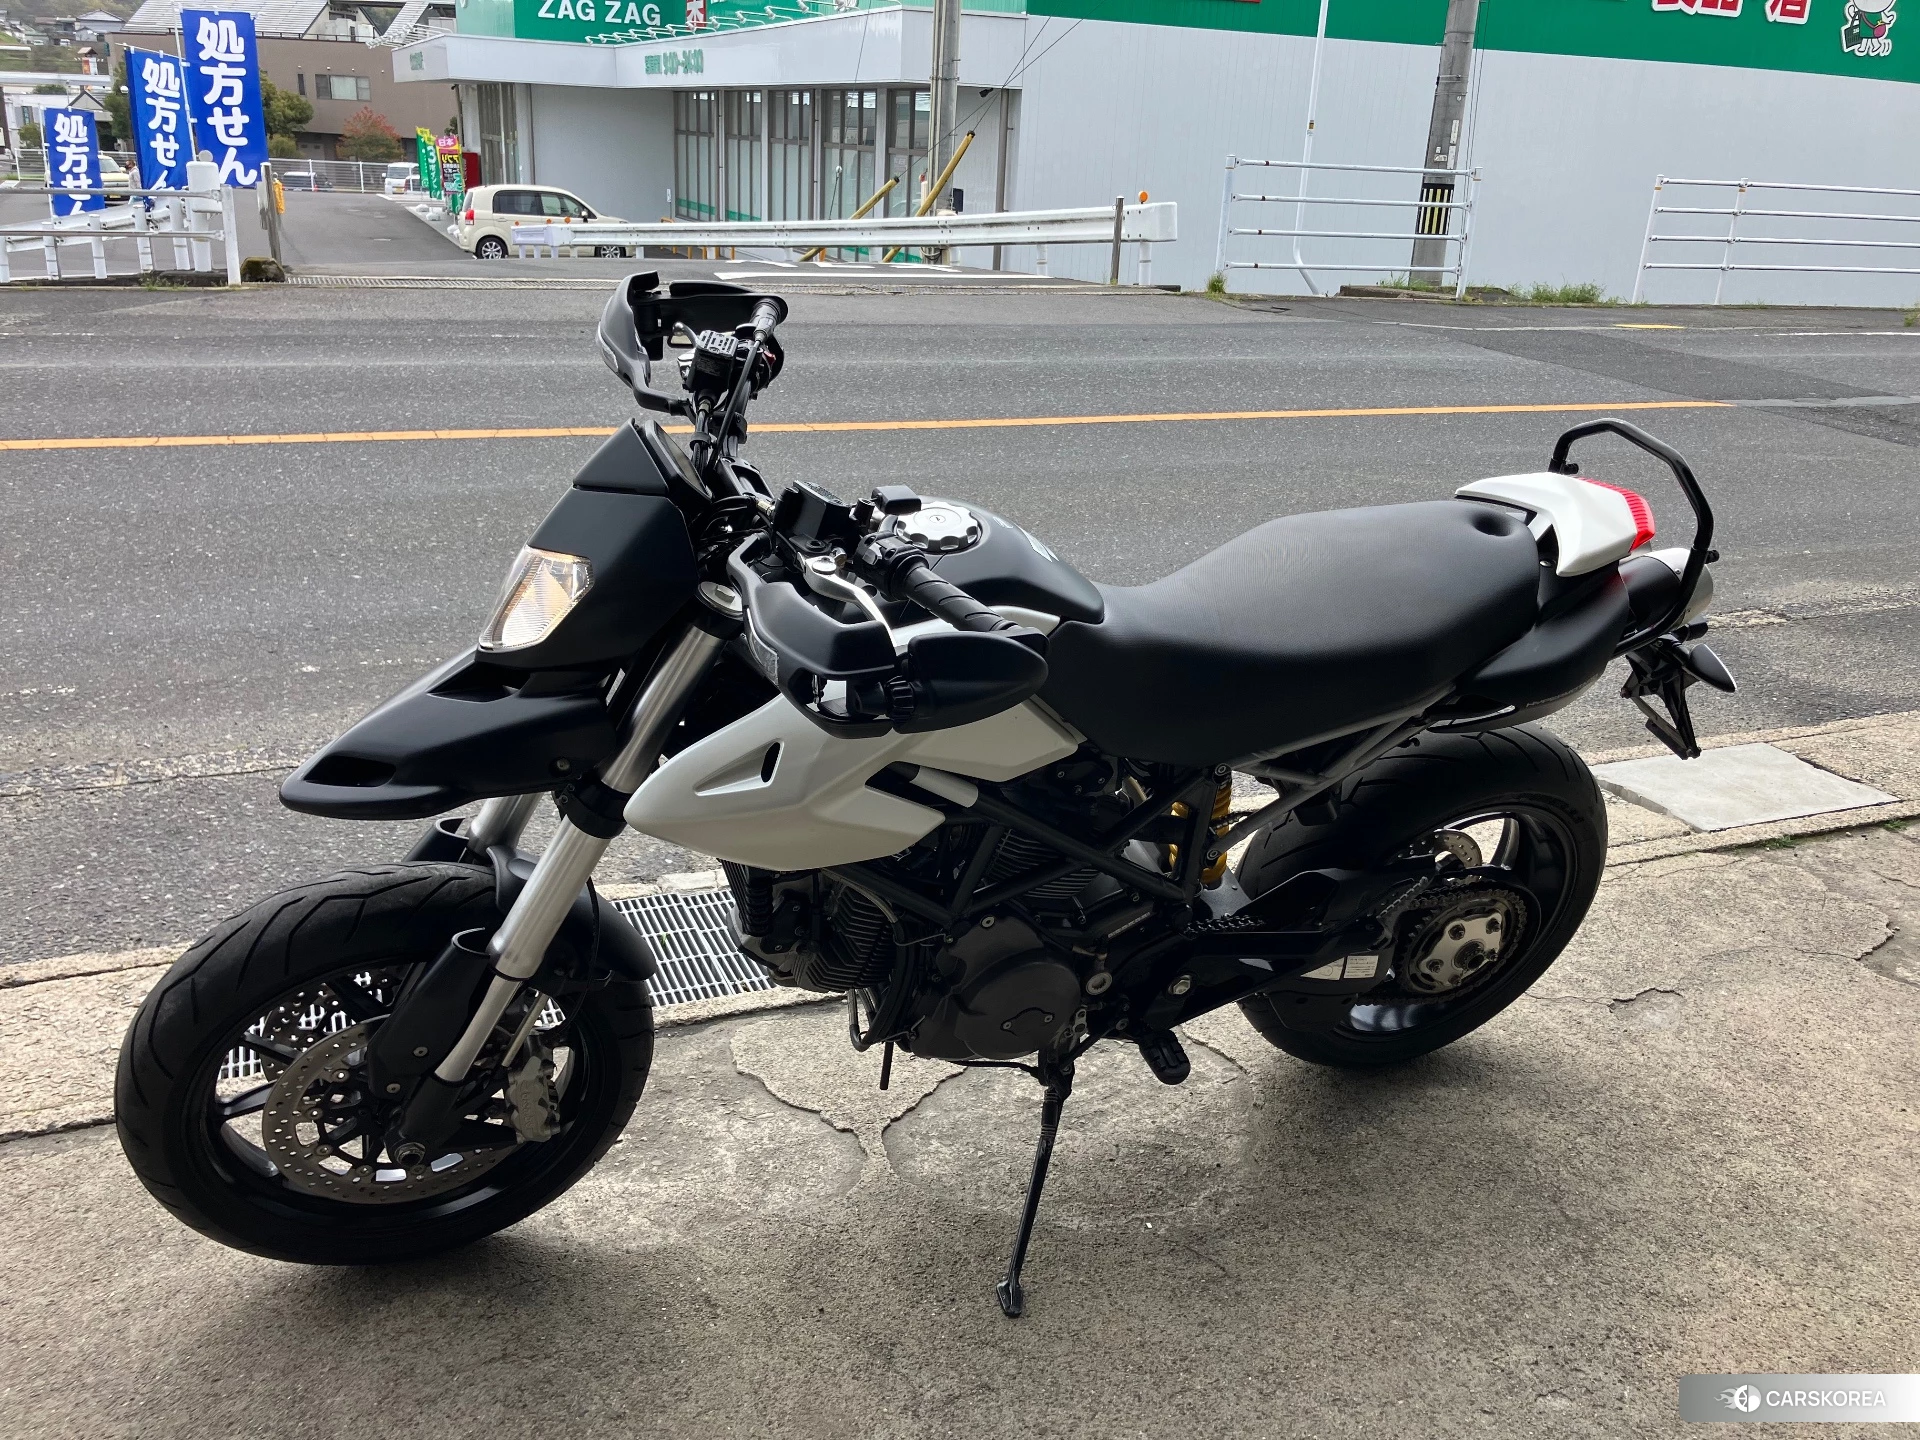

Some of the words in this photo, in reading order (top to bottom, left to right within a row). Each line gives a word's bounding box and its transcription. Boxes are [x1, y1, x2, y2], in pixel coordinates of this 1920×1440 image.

[538, 0, 596, 22] ZAG
[605, 1, 661, 26] ZAG
[196, 16, 257, 186] 処方せん
